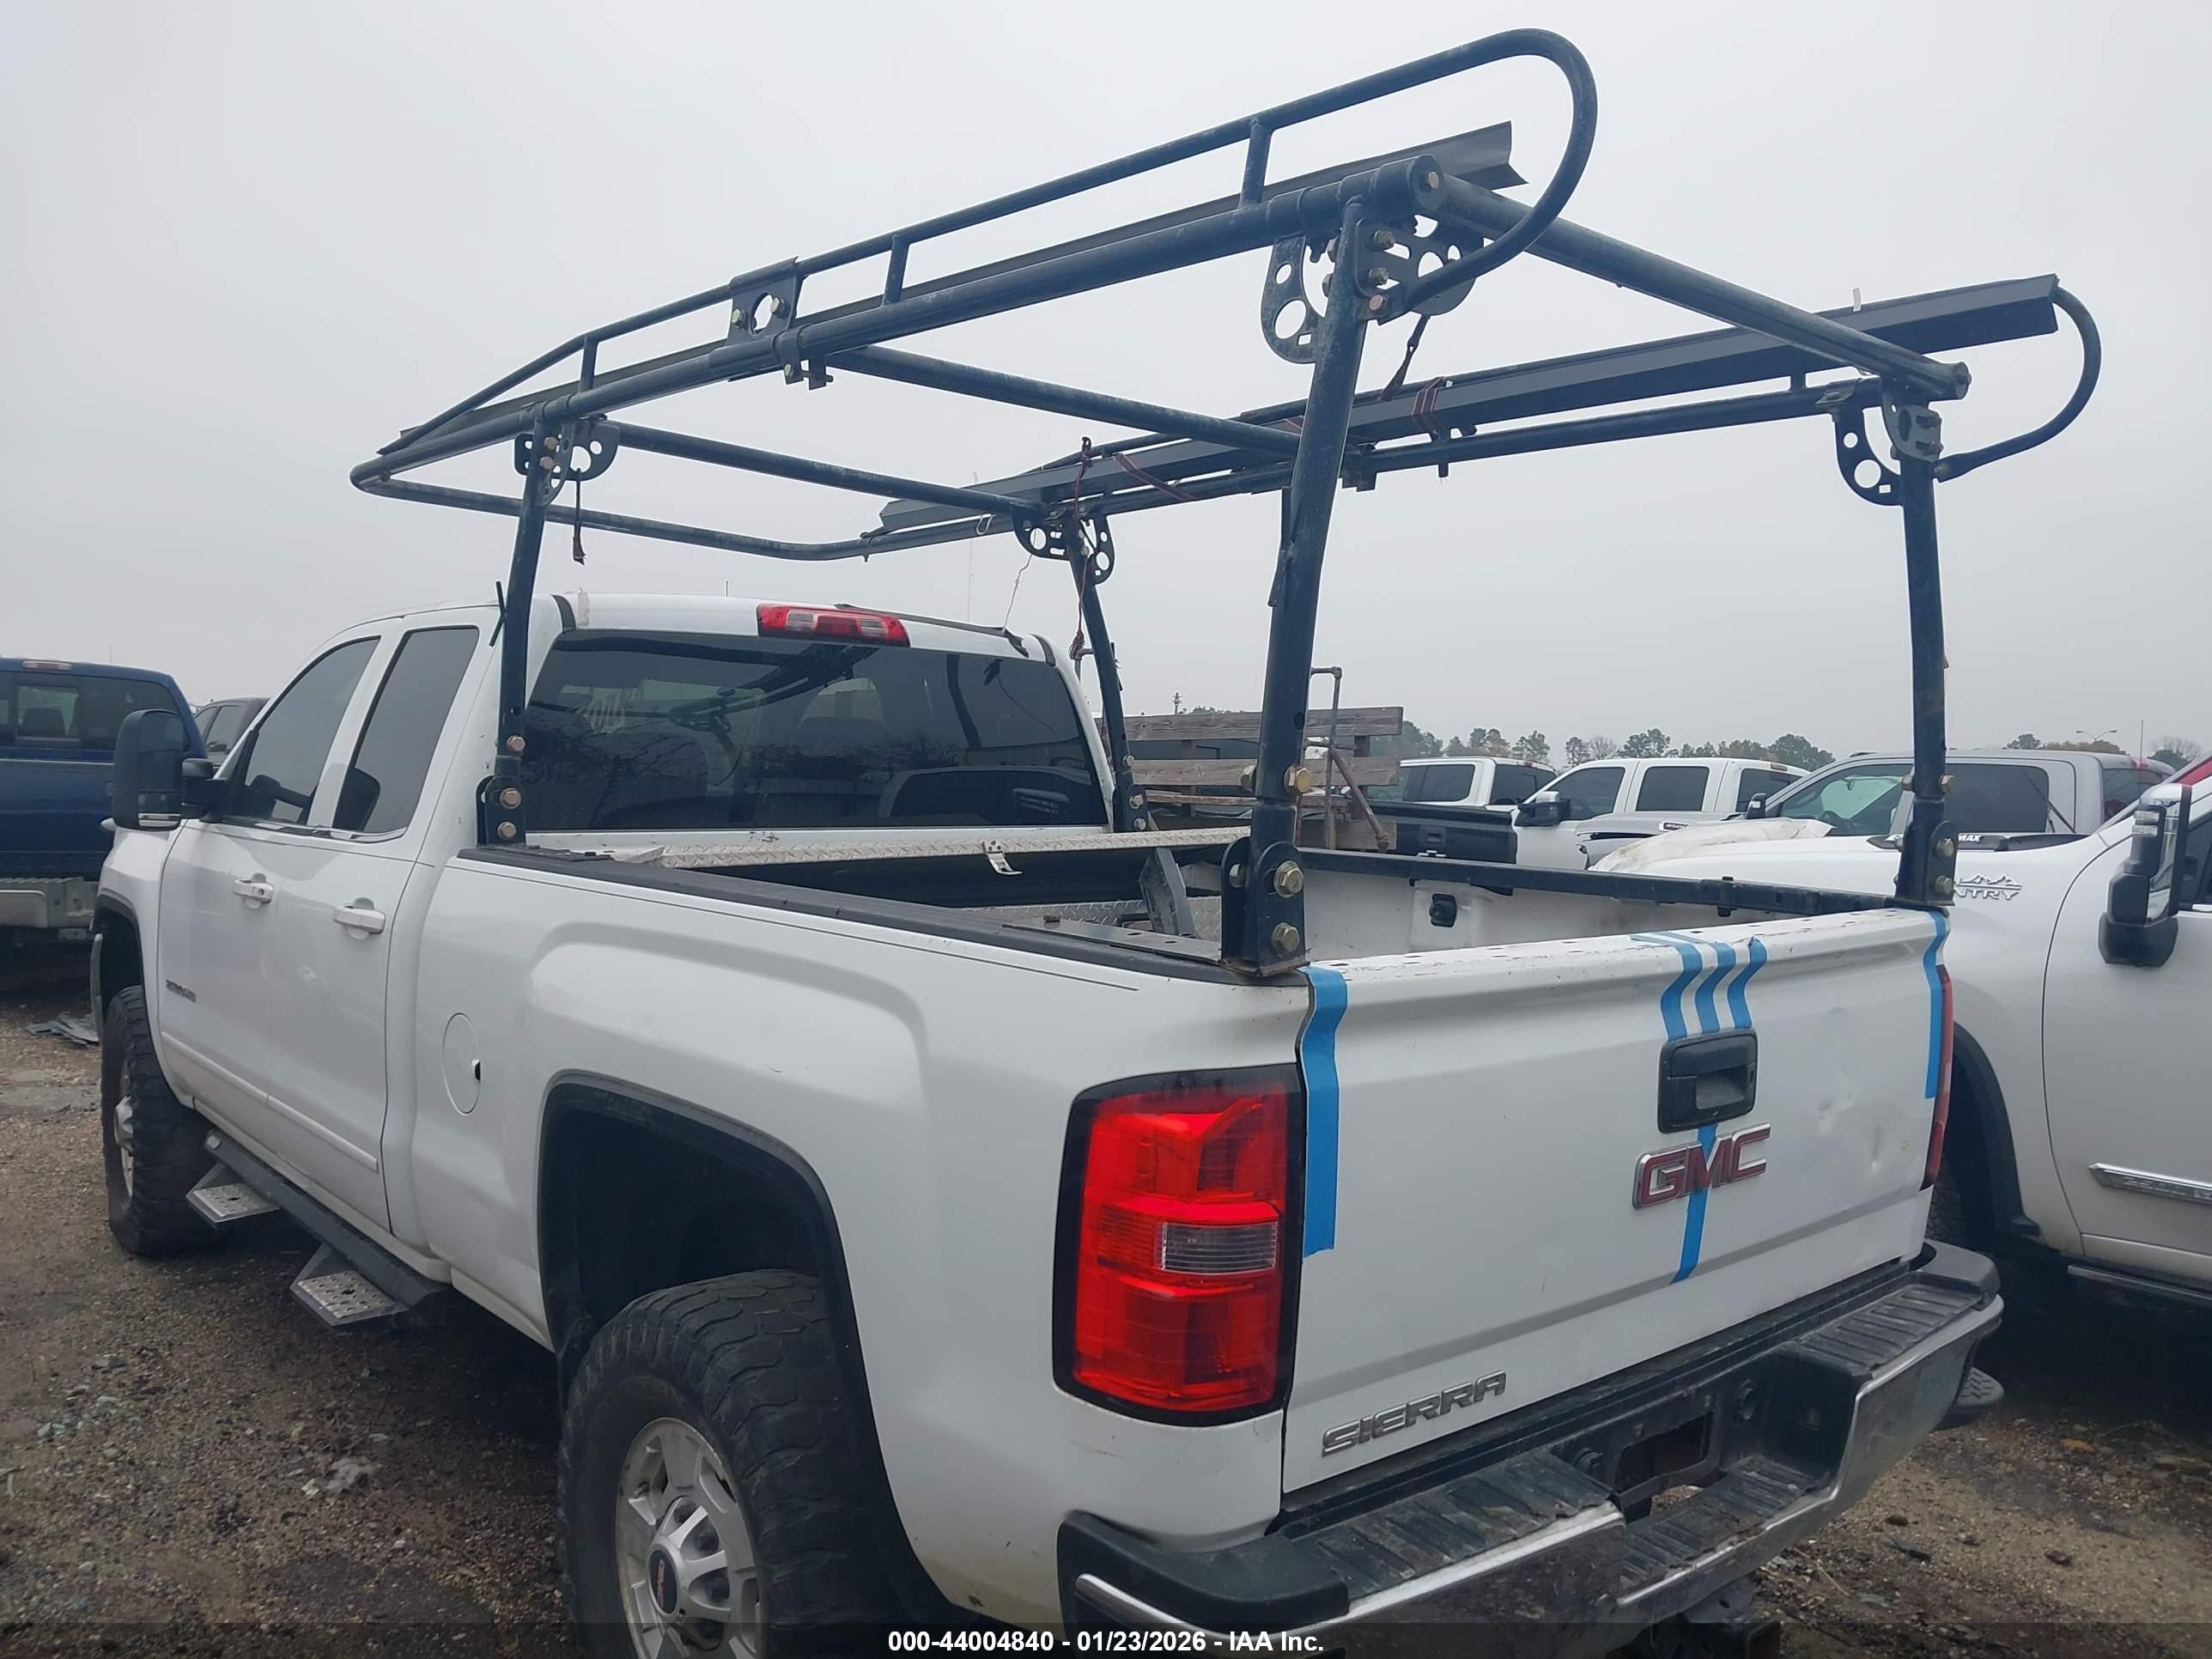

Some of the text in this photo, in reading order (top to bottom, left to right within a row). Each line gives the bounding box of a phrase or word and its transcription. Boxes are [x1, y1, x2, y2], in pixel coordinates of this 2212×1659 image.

[1954, 888, 2020, 900] NTRY
[1632, 1122, 1771, 1209] GMC
[1322, 1370, 1506, 1457] SIERRA
